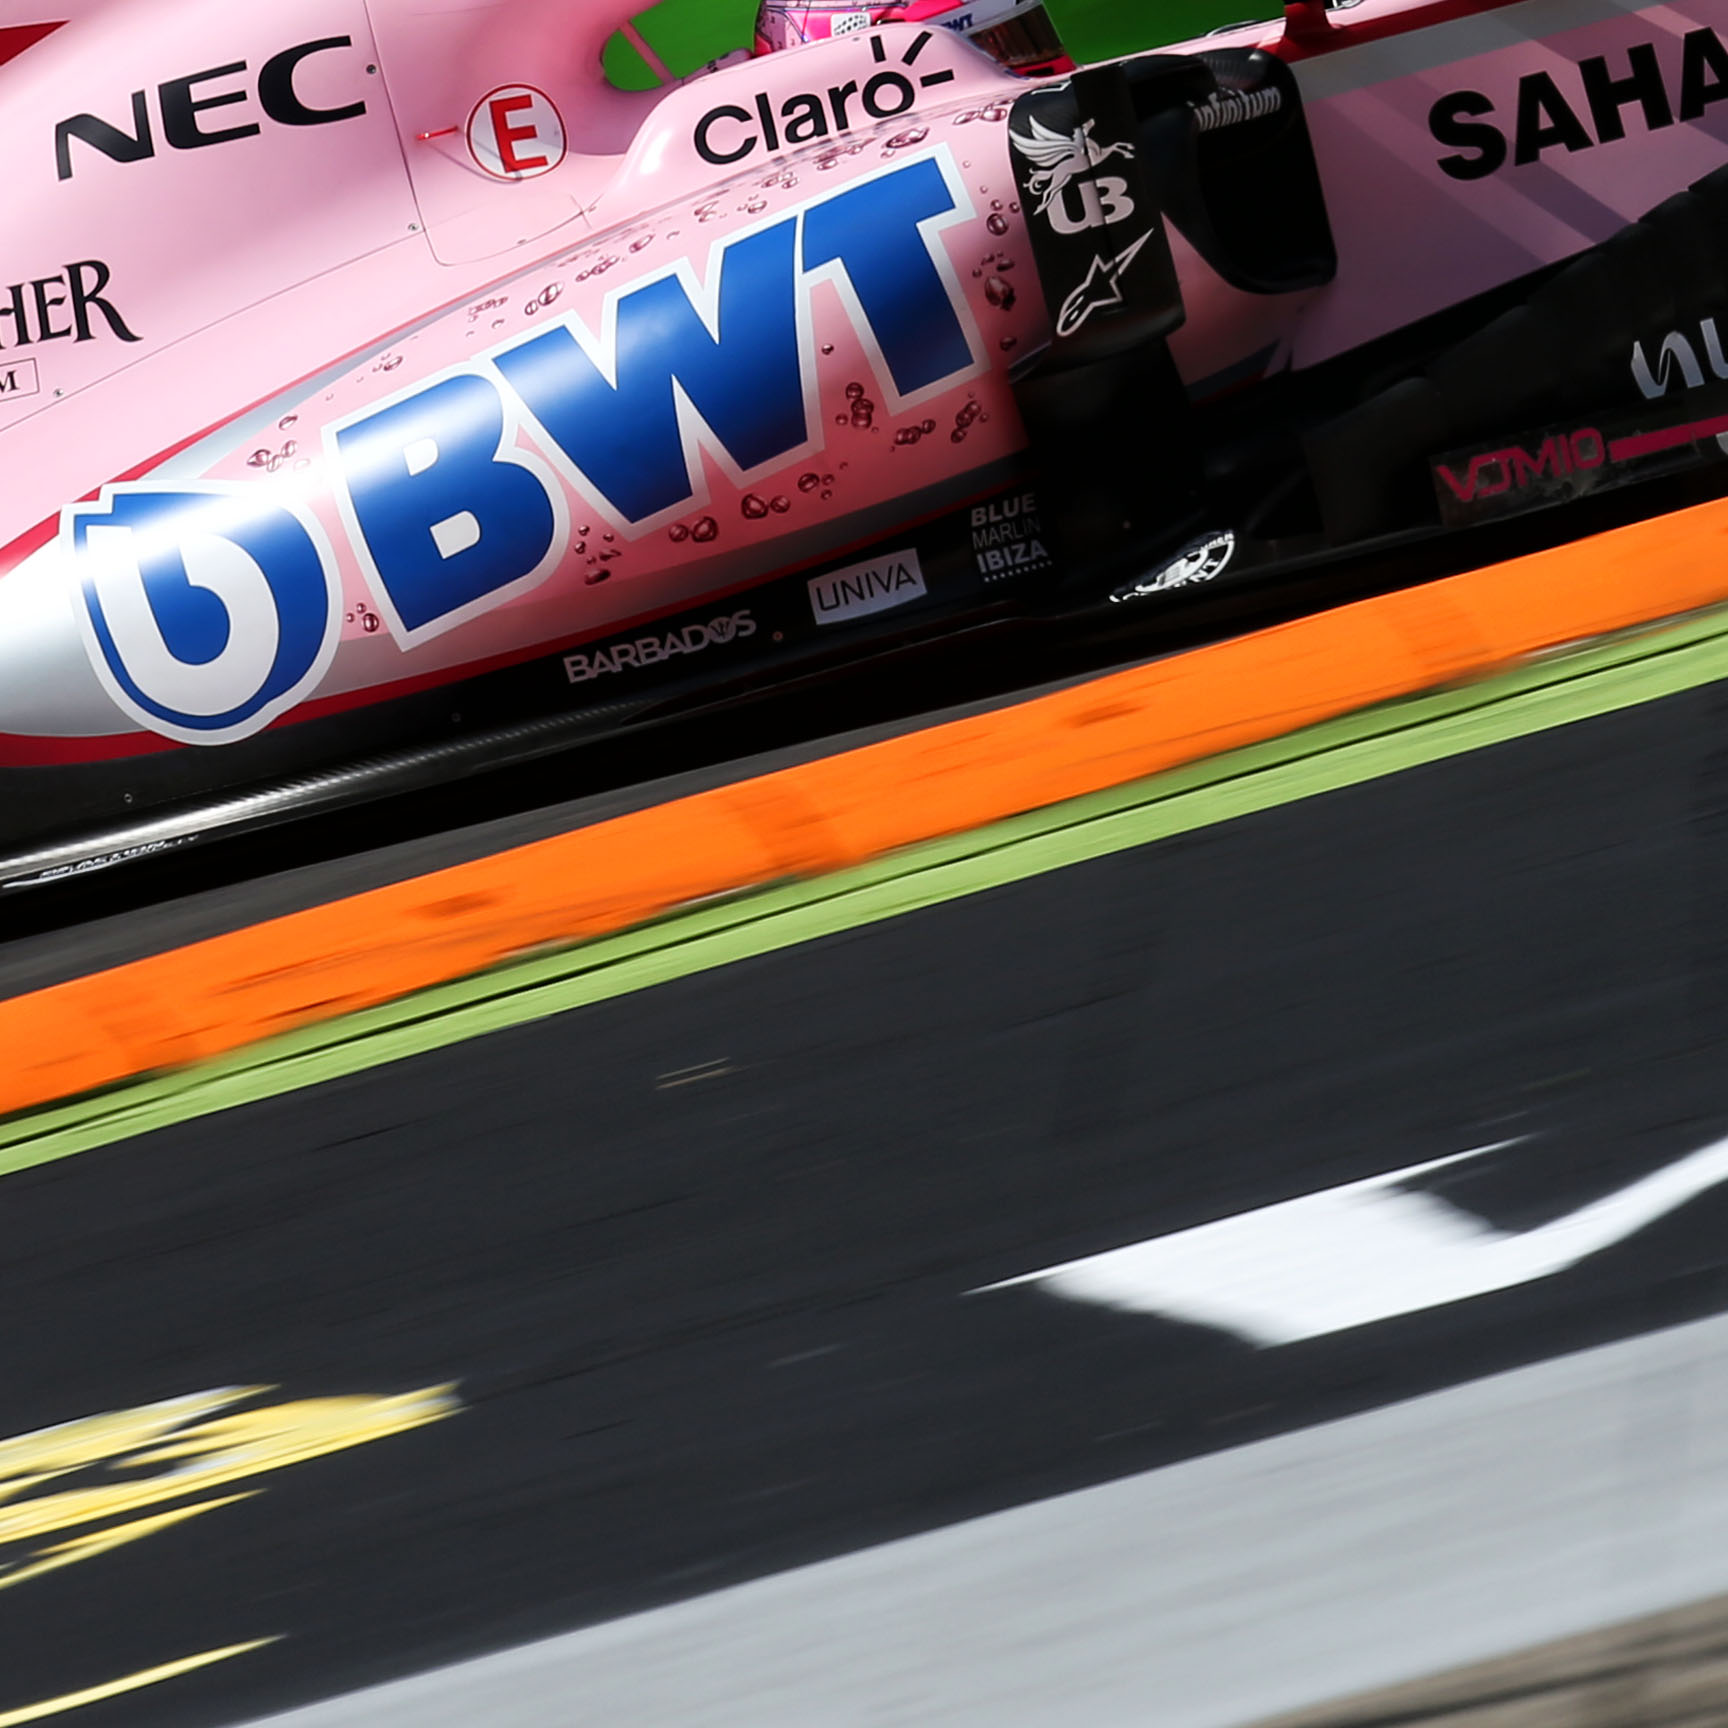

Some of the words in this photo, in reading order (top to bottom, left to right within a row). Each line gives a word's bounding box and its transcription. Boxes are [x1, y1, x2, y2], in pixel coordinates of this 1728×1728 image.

[55, 35, 366, 182] NEC
[488, 93, 549, 174] E
[694, 69, 915, 165] Claro
[1186, 85, 1282, 131] infinitum
[329, 149, 978, 642] BWT
[972, 493, 1036, 528] BLUE
[972, 517, 1041, 551] MARLIN
[976, 538, 1049, 574] IBIZA
[814, 562, 918, 615] UNIVA
[563, 609, 757, 684] BARBADOS
